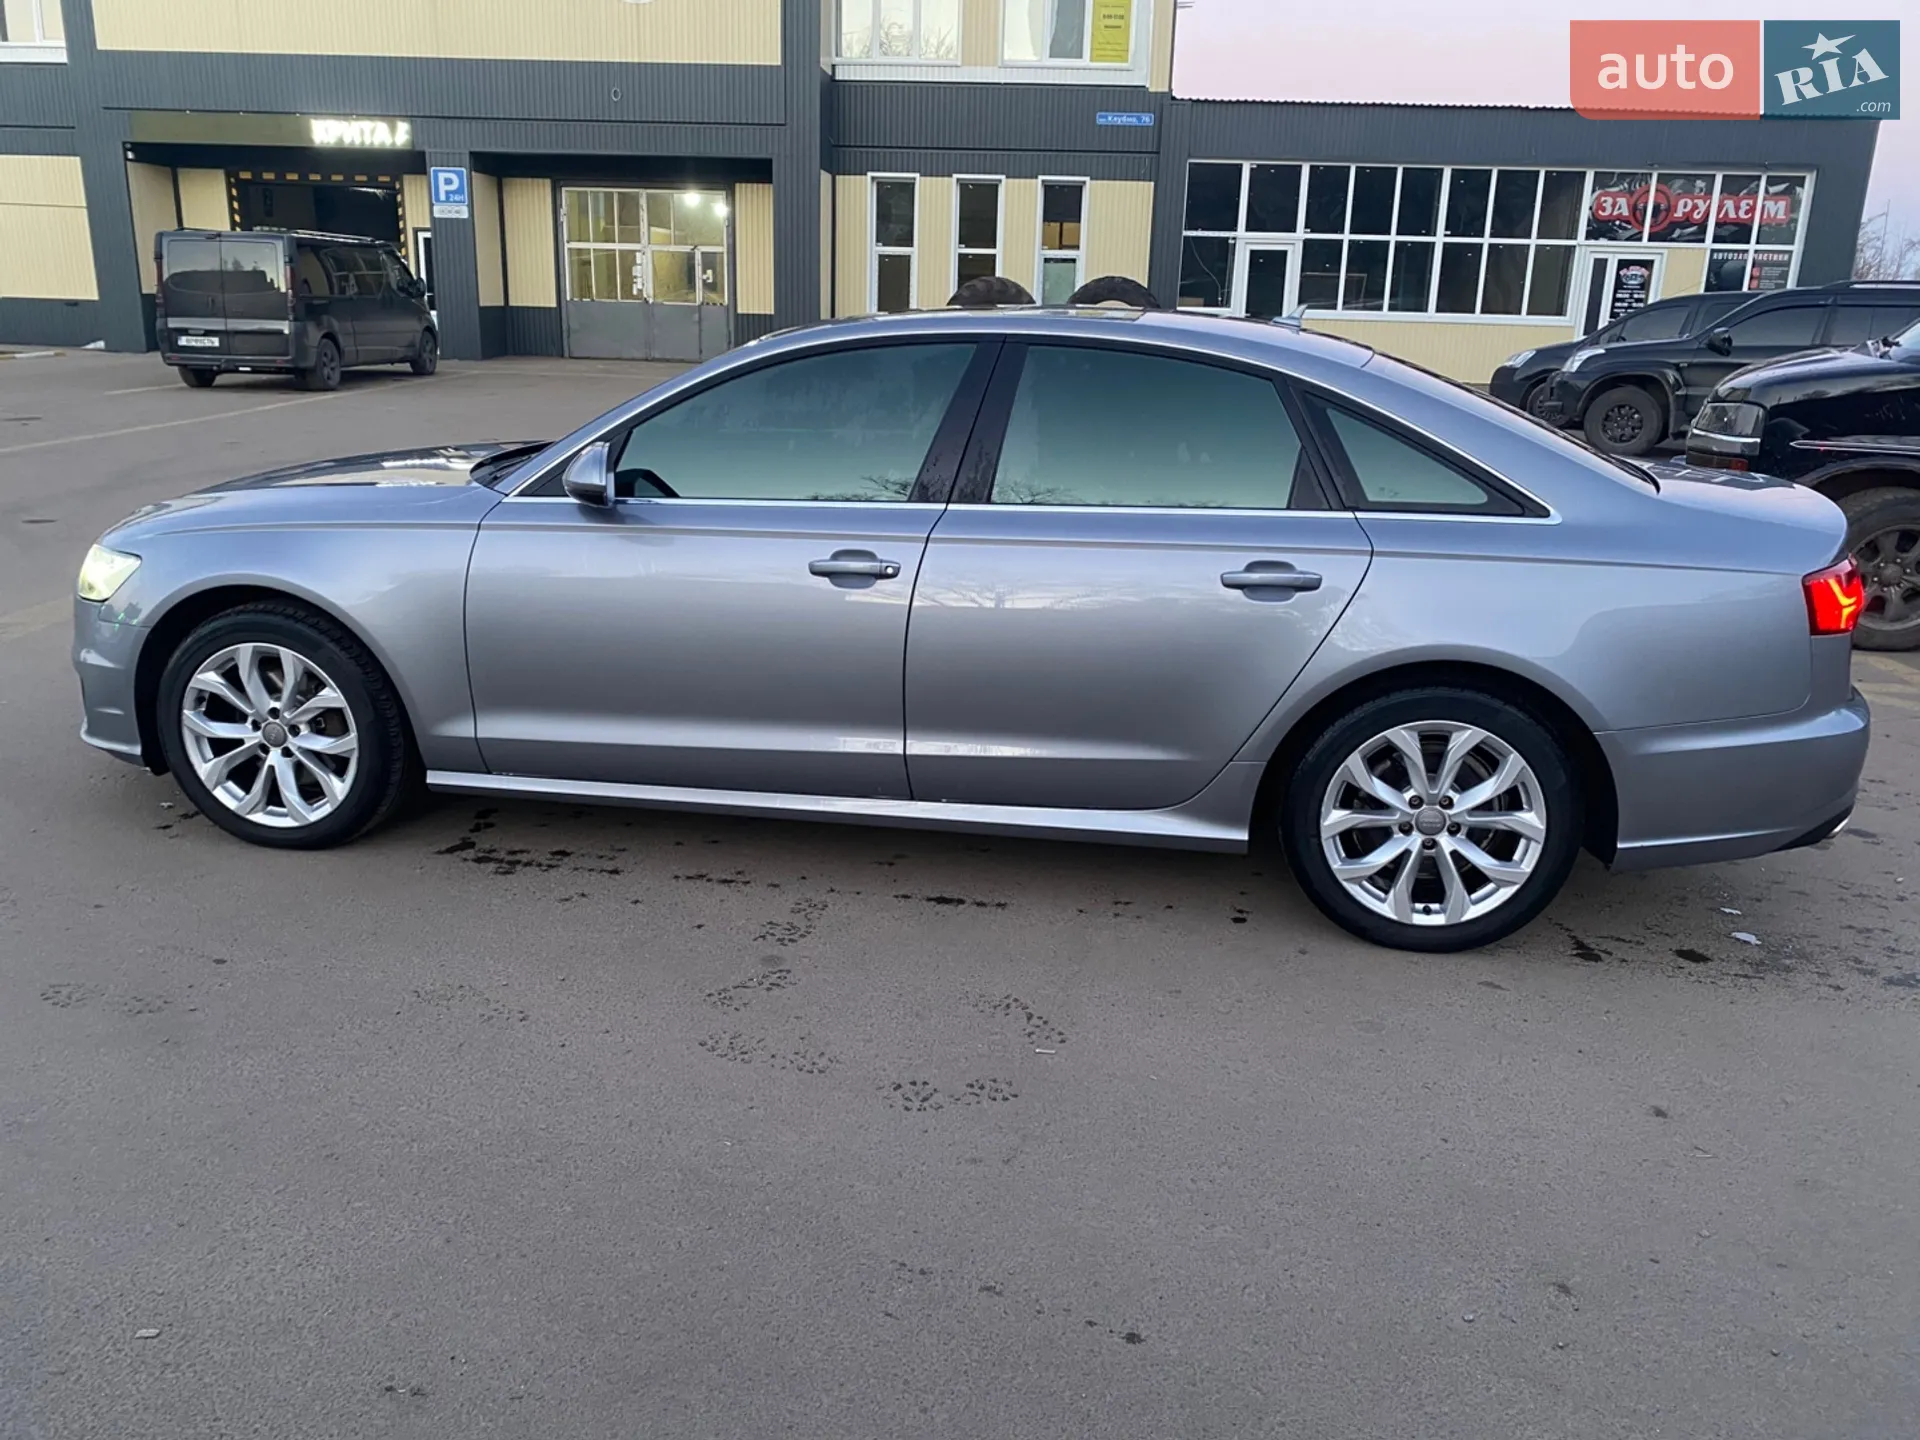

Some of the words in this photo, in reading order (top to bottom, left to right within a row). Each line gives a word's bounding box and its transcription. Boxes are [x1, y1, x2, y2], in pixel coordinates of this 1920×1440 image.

[438, 172, 460, 201] P
[1598, 196, 1630, 217] ЗА
[1673, 198, 1787, 220] РУЛЕМ
